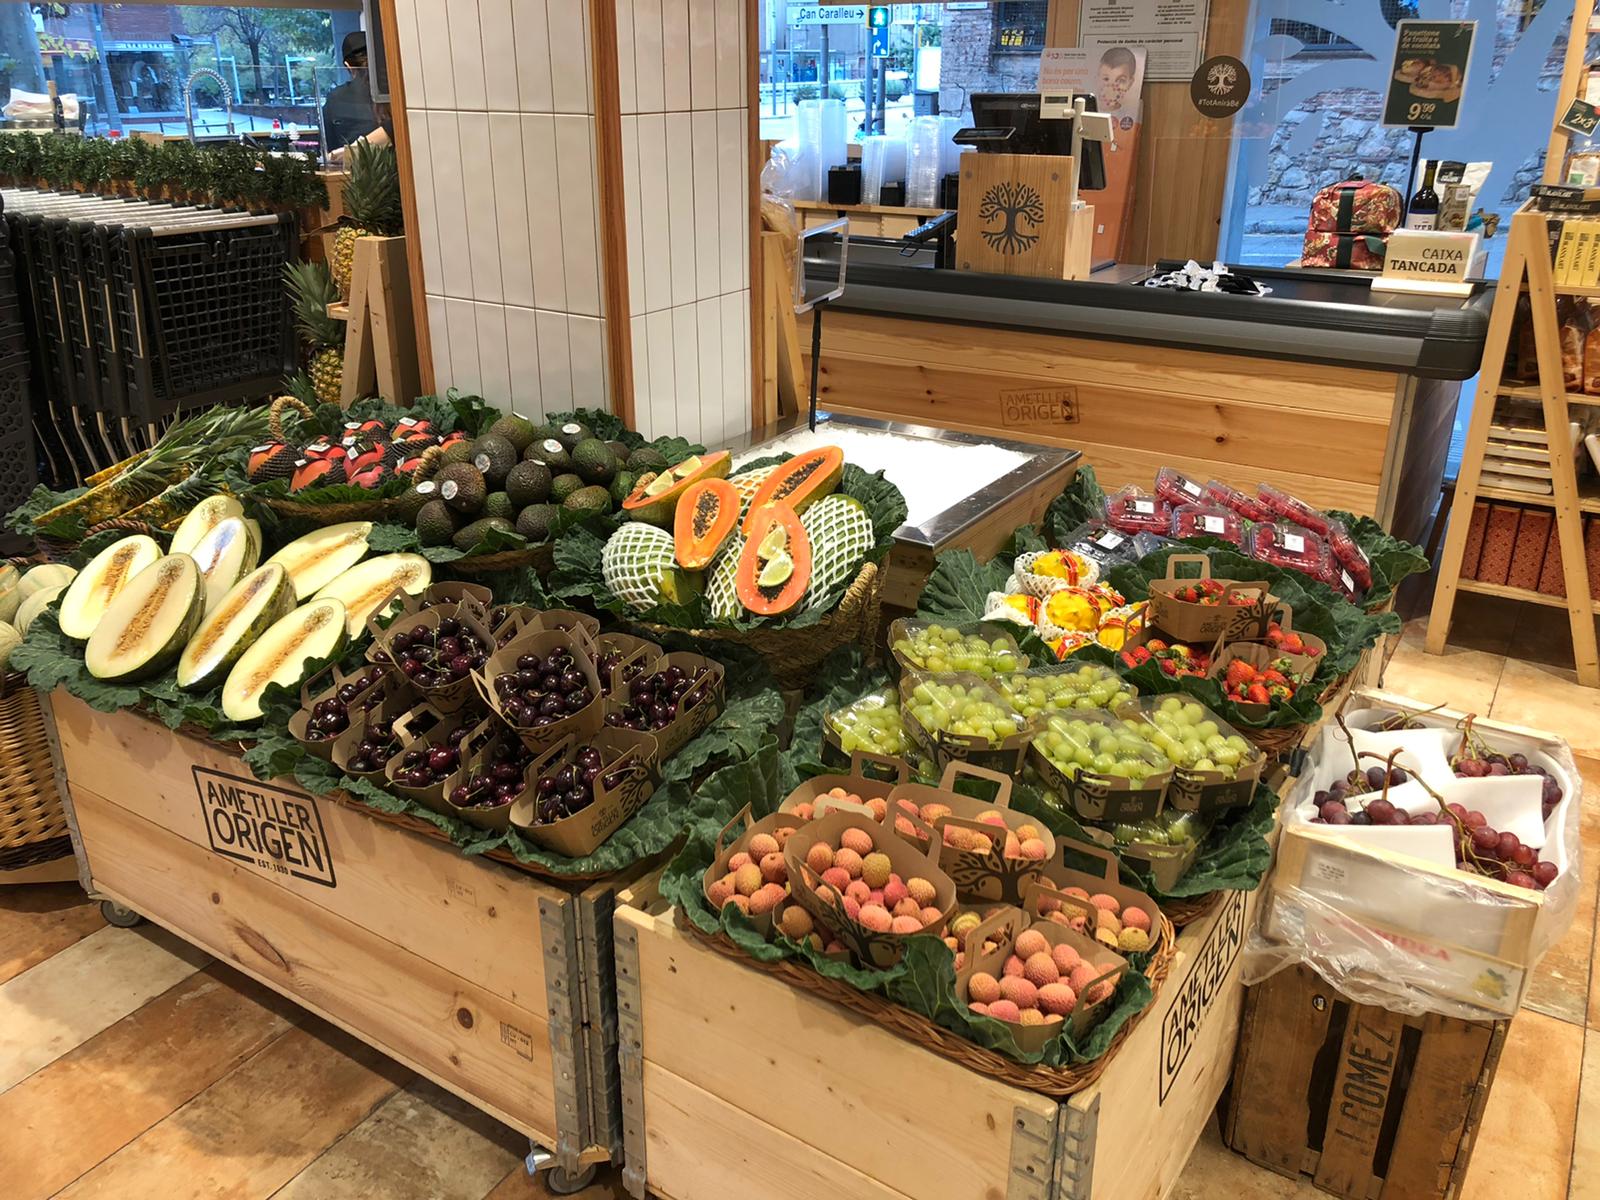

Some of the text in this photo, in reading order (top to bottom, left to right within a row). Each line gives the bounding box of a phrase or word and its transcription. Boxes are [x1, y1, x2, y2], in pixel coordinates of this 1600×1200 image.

[800, 8, 854, 19] Can Caralleu
[1422, 248, 1463, 261] CAIXA
[1390, 259, 1457, 274] TANCADA
[1006, 391, 1071, 406] AMETLLER
[1007, 404, 1072, 421] ORIGEN
[207, 780, 316, 834] AMETLLER
[213, 808, 324, 873] ORIGEN
[1168, 890, 1241, 1045] AMETLLER
[1167, 910, 1241, 1076] ORIGEN
